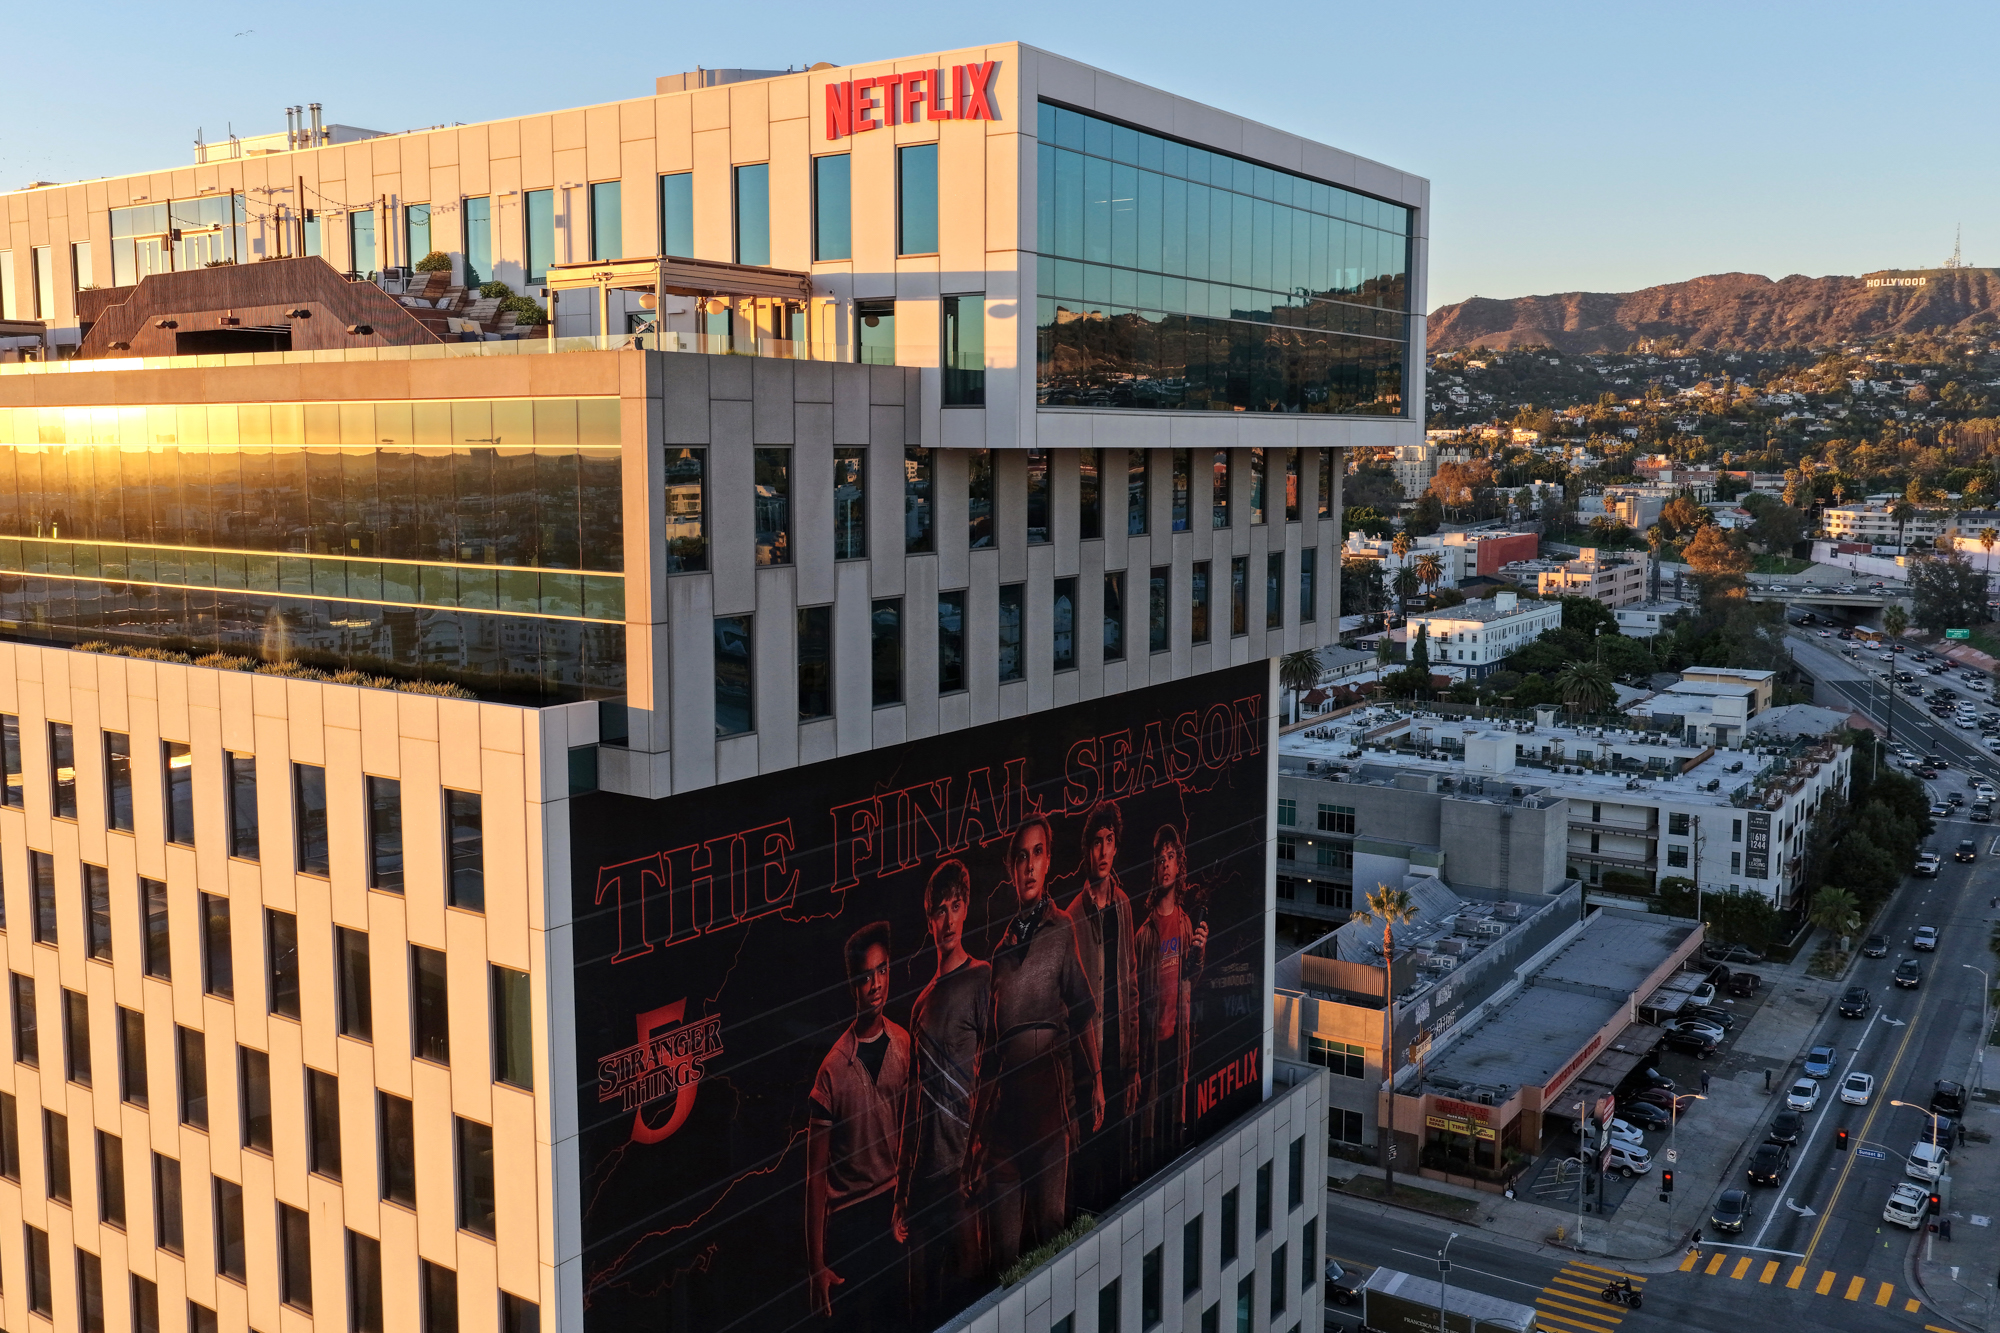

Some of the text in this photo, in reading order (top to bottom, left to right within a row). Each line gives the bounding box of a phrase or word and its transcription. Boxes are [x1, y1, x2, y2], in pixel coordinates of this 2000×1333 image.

[826, 61, 995, 140] NETFLIX
[1866, 277, 1926, 287] HOLLYWOOD
[595, 694, 1261, 964] THE FINAL SEASON
[598, 1020, 723, 1097] STRANGER
[620, 1055, 705, 1112] THINGS
[631, 996, 687, 1144] 5
[1198, 1047, 1258, 1119] NETFLIX
[1436, 1099, 1489, 1113] AMERICAN
[1452, 1123, 1469, 1131] TIRES
[1404, 1317, 1432, 1329] FRANCESCA
